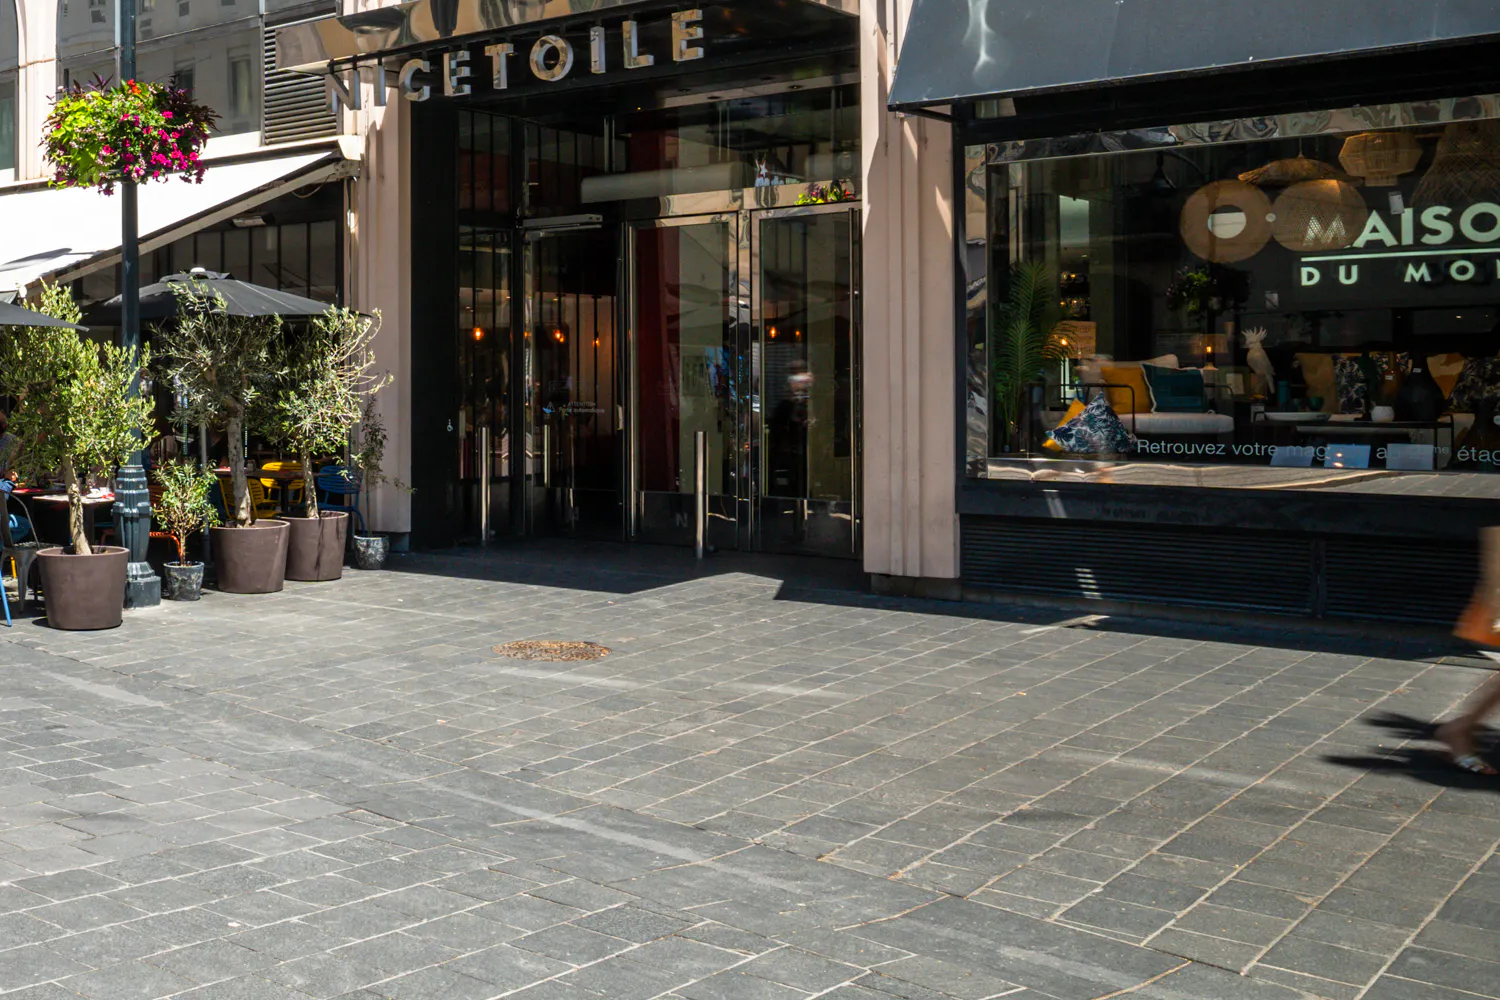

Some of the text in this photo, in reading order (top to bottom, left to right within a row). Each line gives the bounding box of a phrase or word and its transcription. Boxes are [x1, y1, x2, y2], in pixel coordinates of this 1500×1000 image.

[324, 9, 704, 113] NICETOILE
[1301, 258, 1500, 286] DU MO
[1137, 439, 1227, 455] Retrouvez
[1232, 442, 1278, 456] votre
